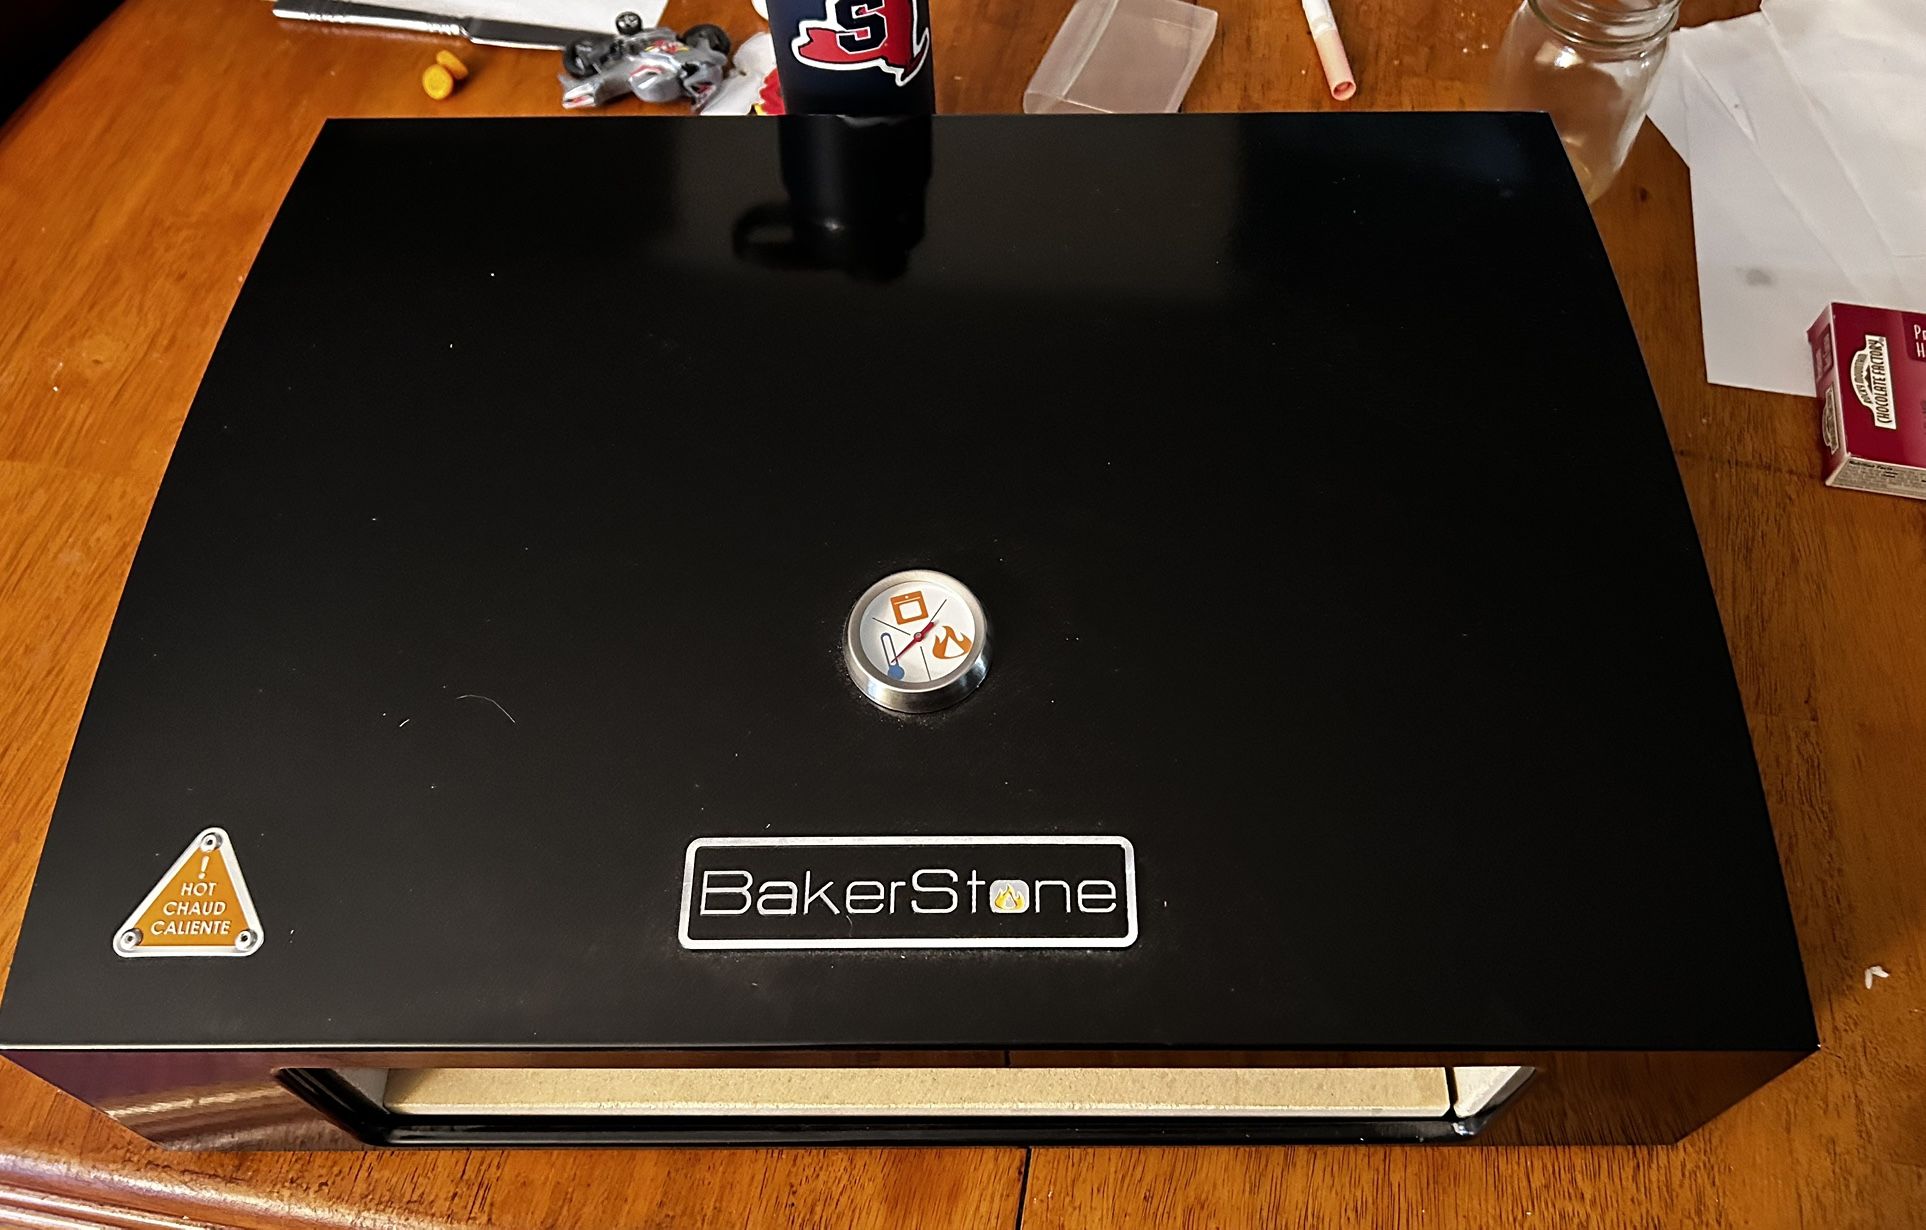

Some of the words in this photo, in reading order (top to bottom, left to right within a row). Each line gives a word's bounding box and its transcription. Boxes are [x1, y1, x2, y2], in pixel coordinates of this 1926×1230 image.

[834, 0, 888, 54] S
[1868, 339, 1886, 376] FACTORY
[1855, 384, 1873, 404] ROCKY
[1872, 376, 1892, 424] CHOCOLATE
[180, 882, 217, 897] HOT
[700, 868, 1117, 915] BakerStone
[163, 901, 226, 916] CHAUD
[150, 920, 231, 936] CALIENTE
